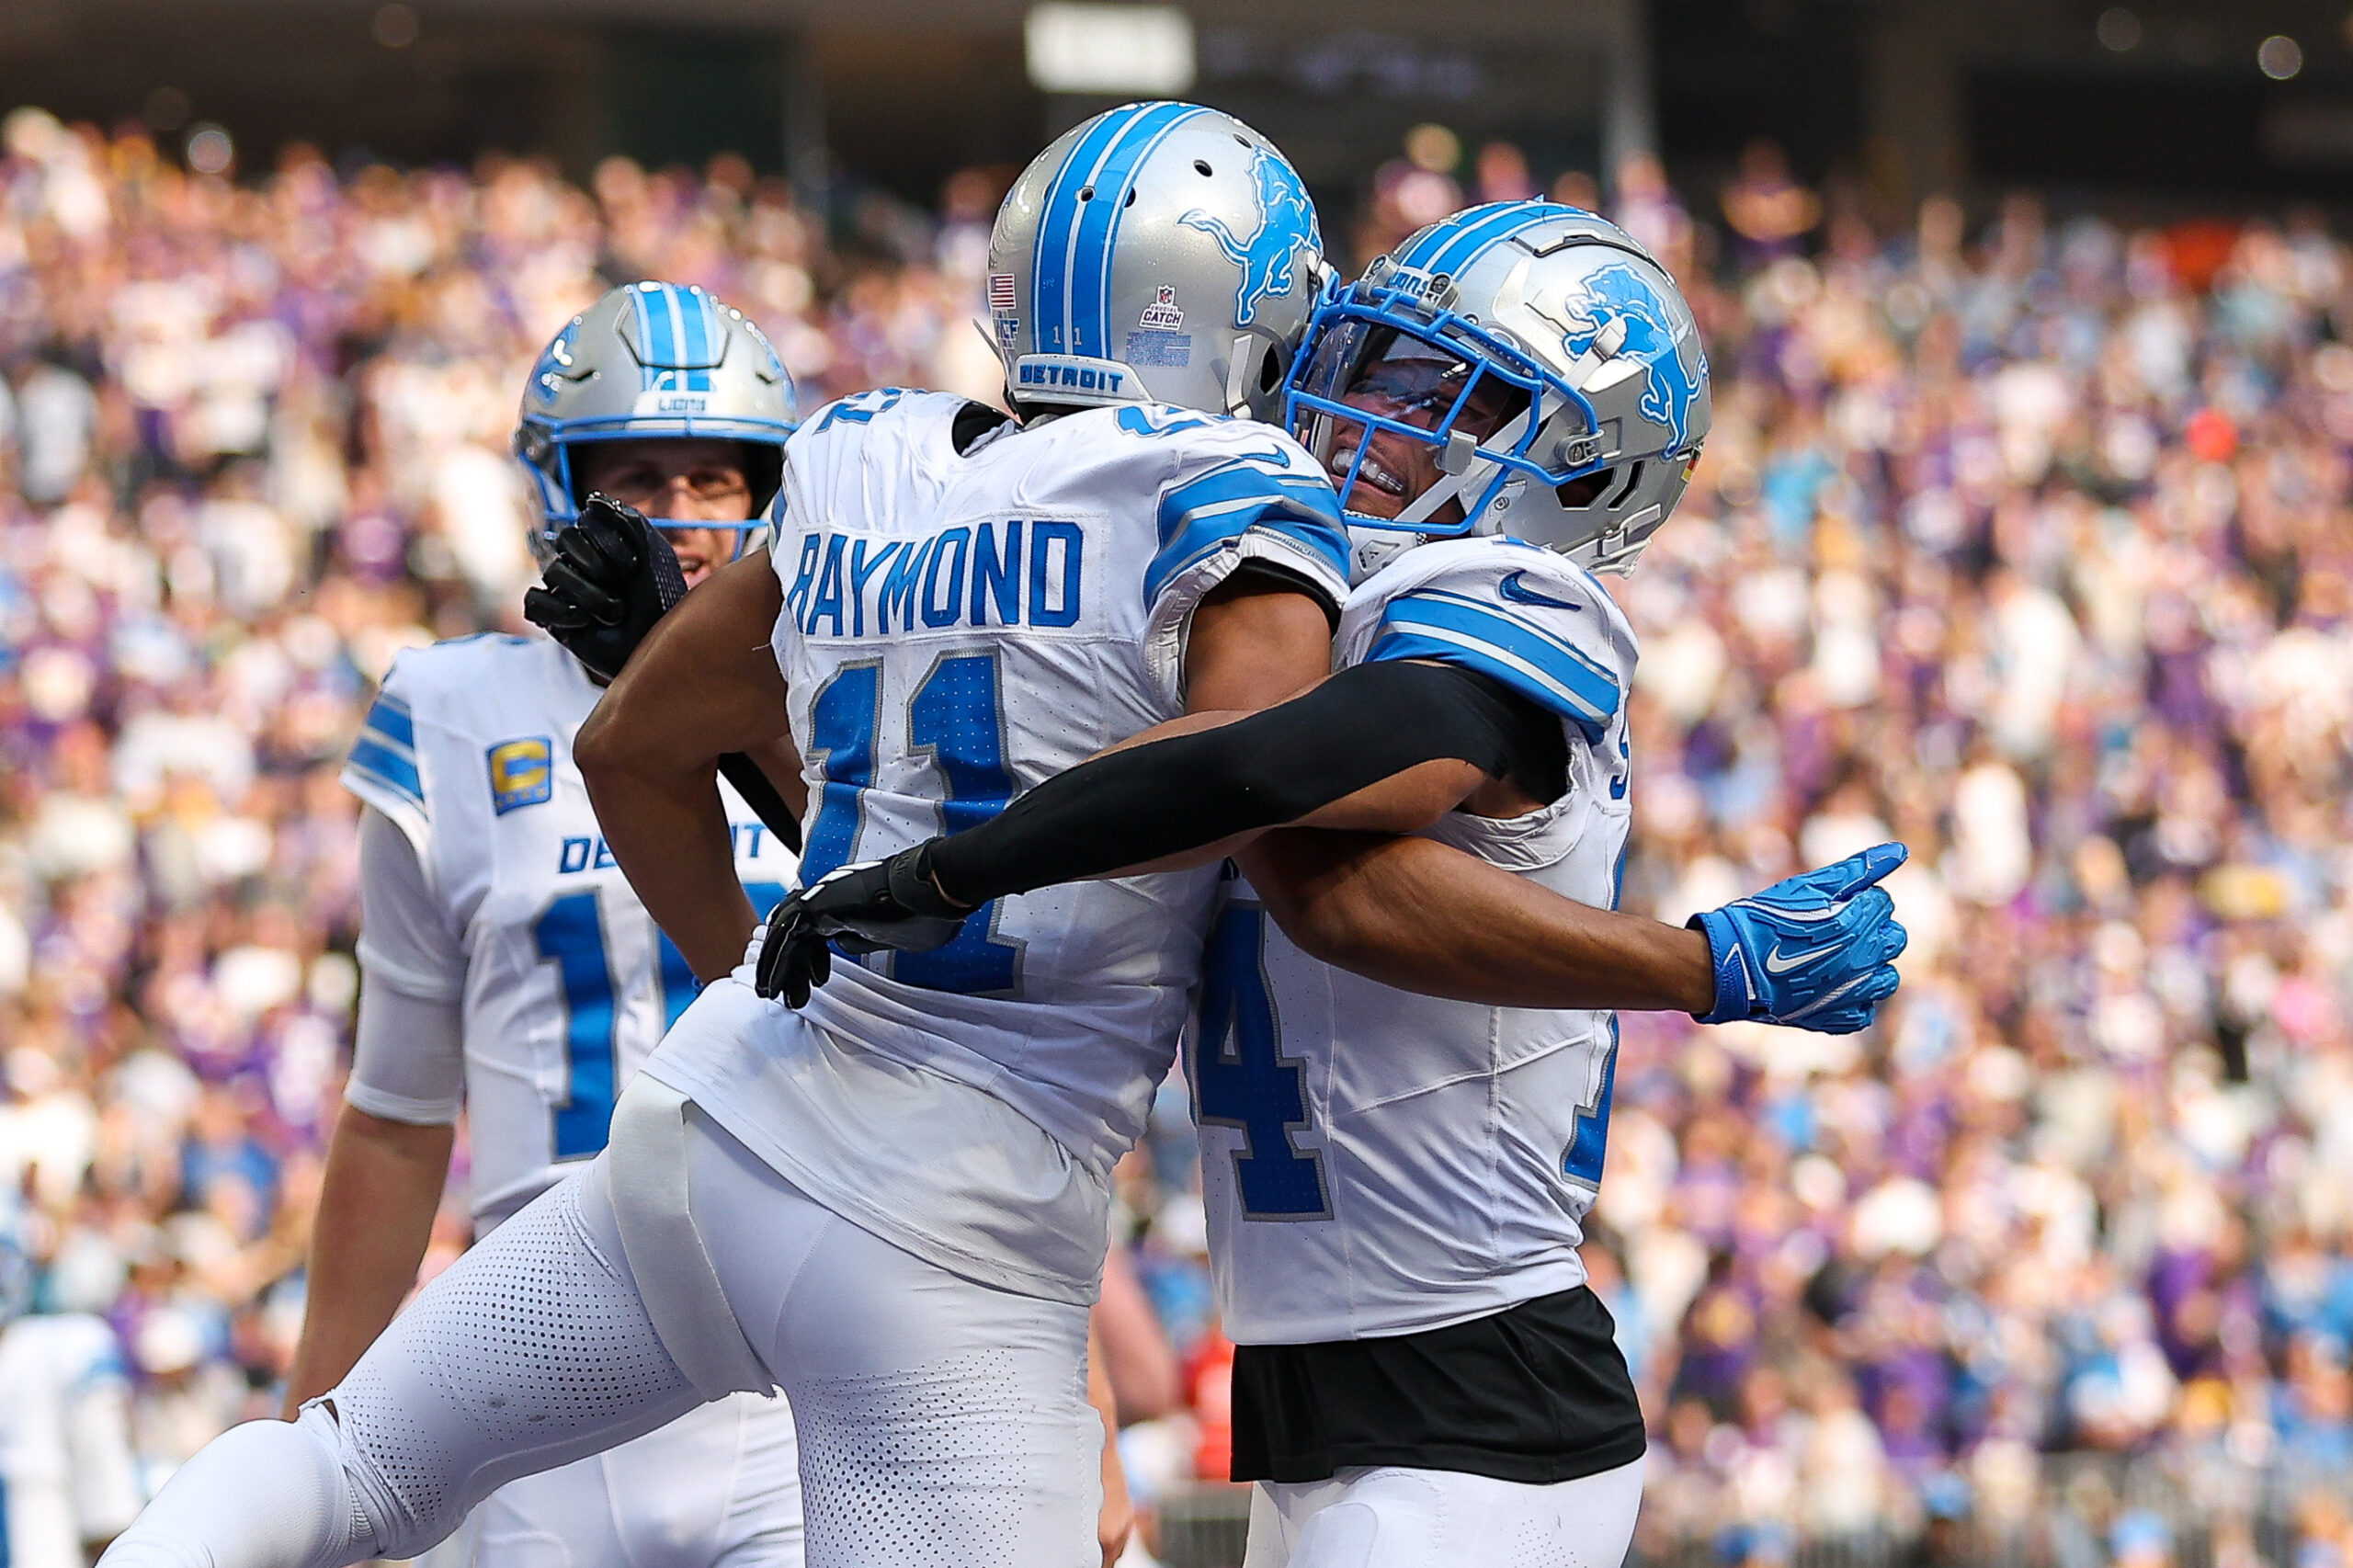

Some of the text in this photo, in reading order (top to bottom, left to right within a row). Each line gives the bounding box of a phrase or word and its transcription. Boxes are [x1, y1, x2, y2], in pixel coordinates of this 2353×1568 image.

[1143, 311, 1181, 324] CATCH
[1019, 364, 1123, 392] DETROIT
[787, 520, 1084, 639] RAYMOND
[489, 742, 548, 791] C
[797, 645, 1028, 996] 11
[1184, 898, 1335, 1221] 4
